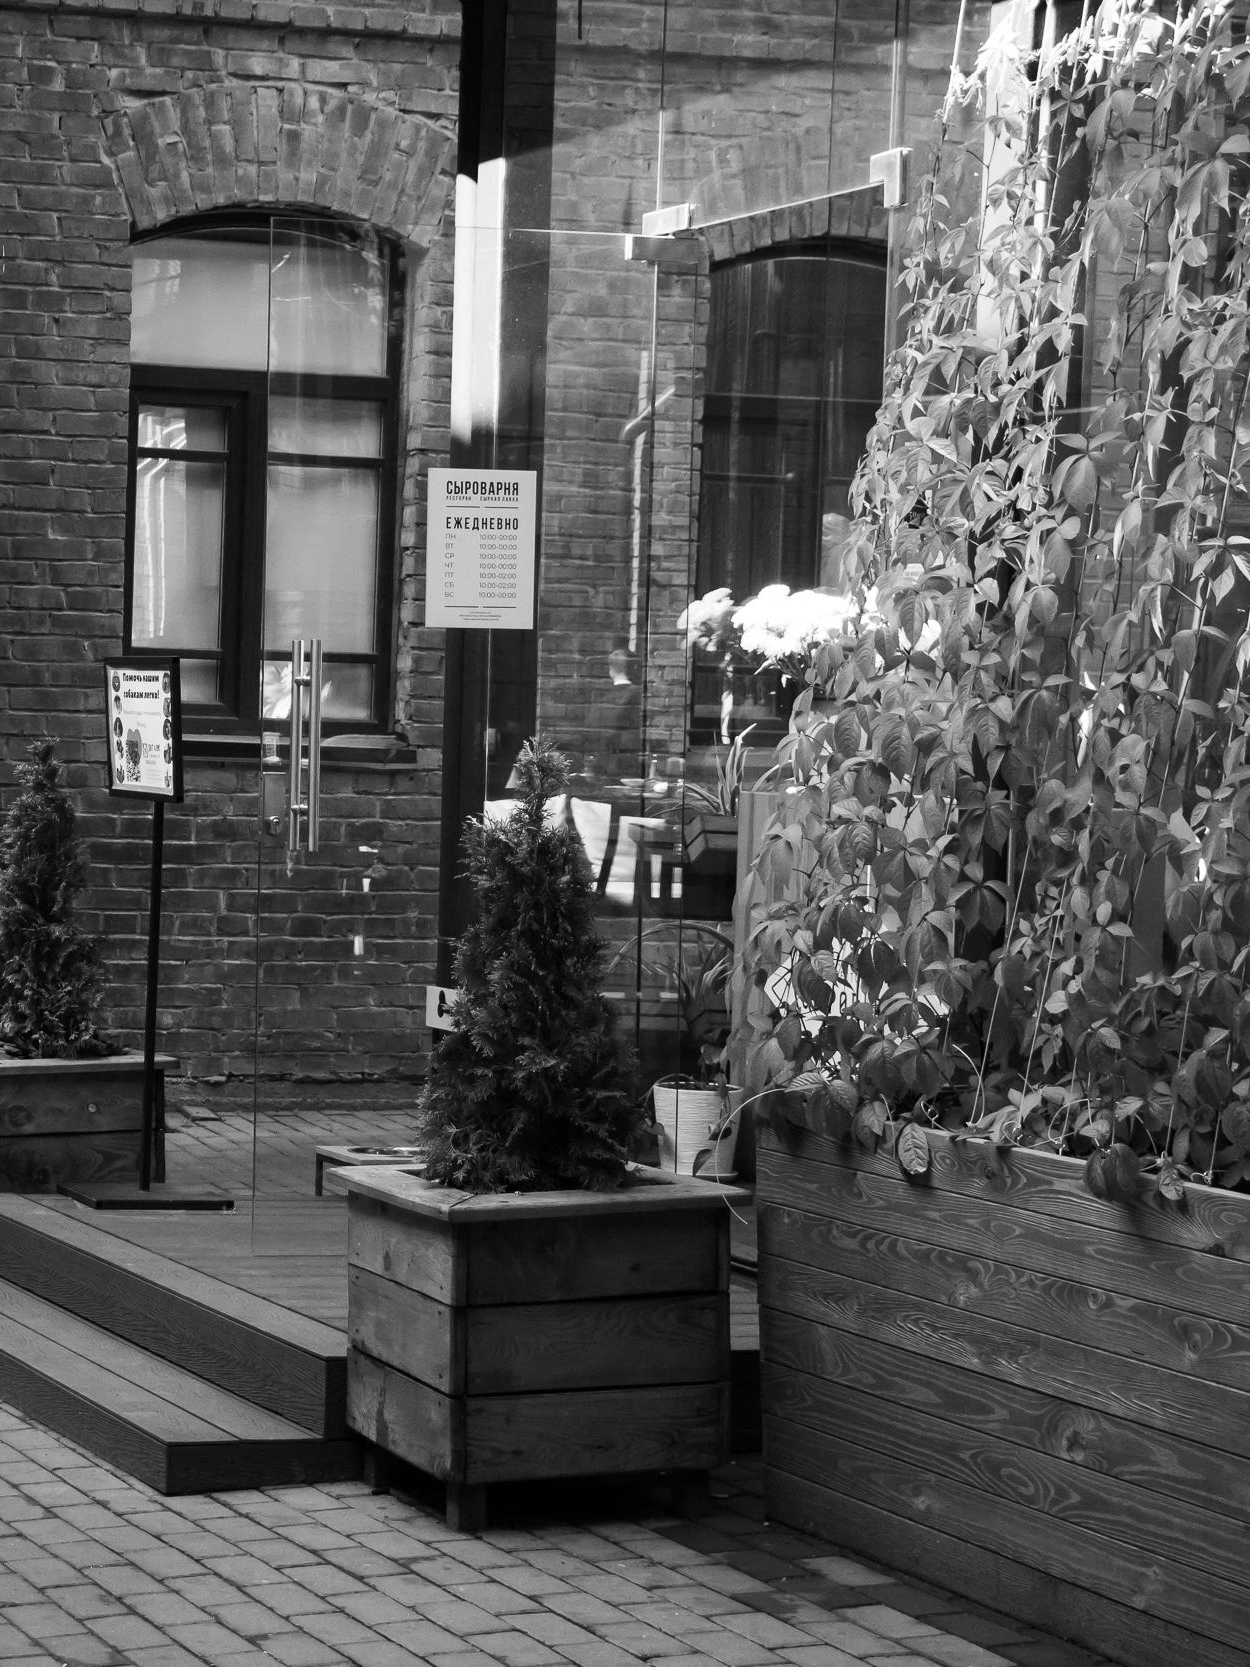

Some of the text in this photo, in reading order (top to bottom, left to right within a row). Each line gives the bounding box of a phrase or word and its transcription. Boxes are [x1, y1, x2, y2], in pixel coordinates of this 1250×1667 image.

[446, 480, 519, 496] СЫРОВАРНЯ
[446, 516, 519, 531] ЕЖЕДНЕВНО
[123, 673, 142, 682] Помочь
